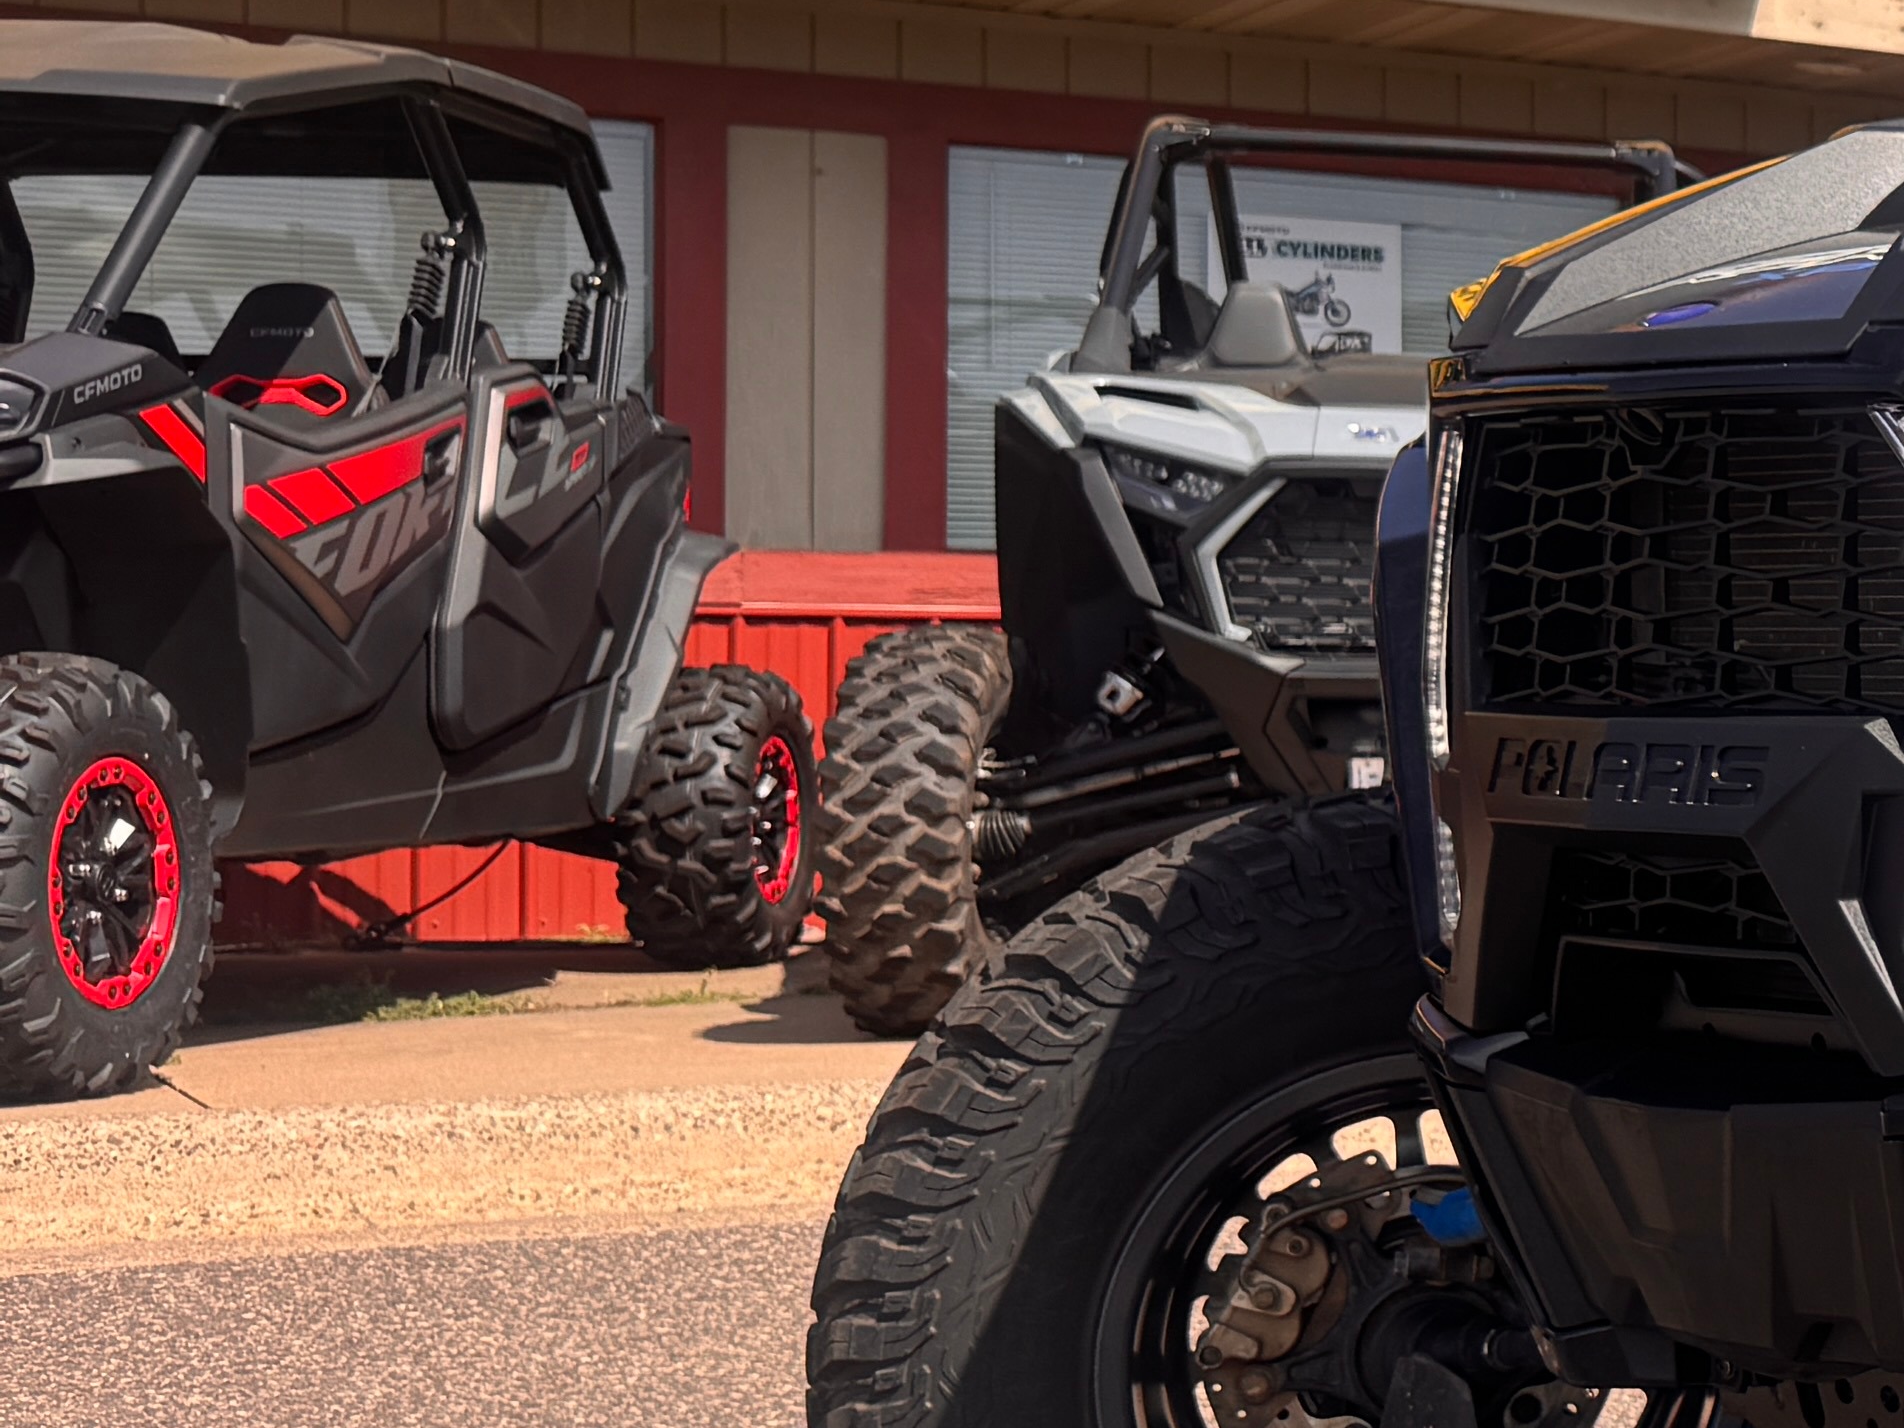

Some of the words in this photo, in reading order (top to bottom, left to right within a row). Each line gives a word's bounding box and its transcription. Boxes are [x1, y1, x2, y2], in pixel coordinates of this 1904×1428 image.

[1276, 240, 1385, 263] CYLINDERS
[73, 363, 143, 405] CFMOTO
[1488, 736, 1770, 808] POLARIS
